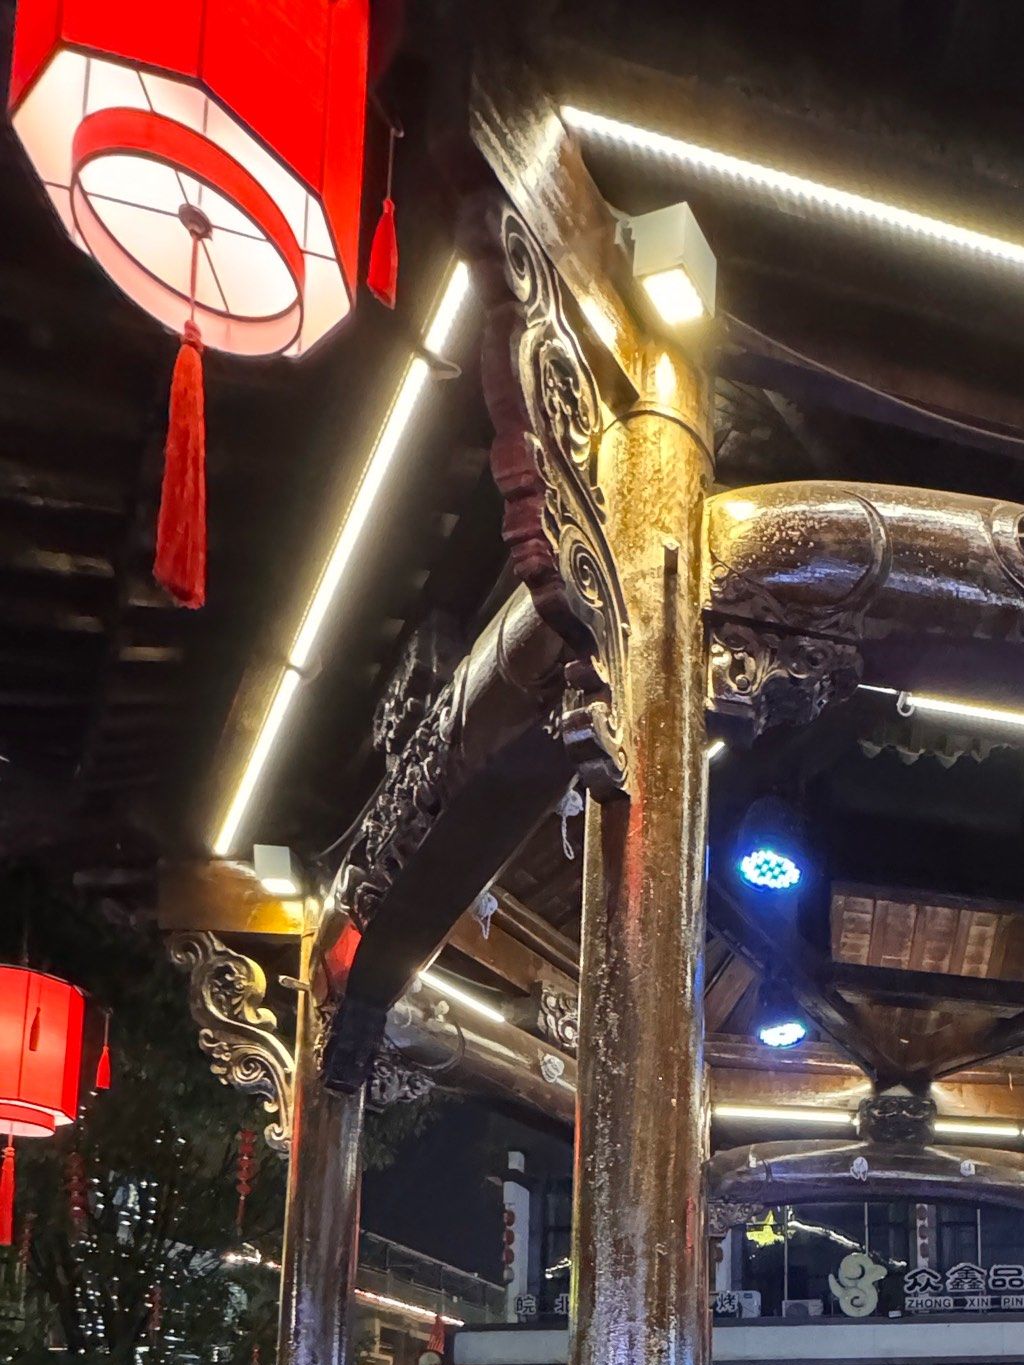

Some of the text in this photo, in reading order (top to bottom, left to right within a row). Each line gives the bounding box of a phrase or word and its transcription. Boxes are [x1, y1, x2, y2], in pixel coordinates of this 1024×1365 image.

[905, 1298, 952, 1309] ZHONG
[968, 1297, 990, 1308] XIN
[1002, 1297, 1024, 1308] PIN
